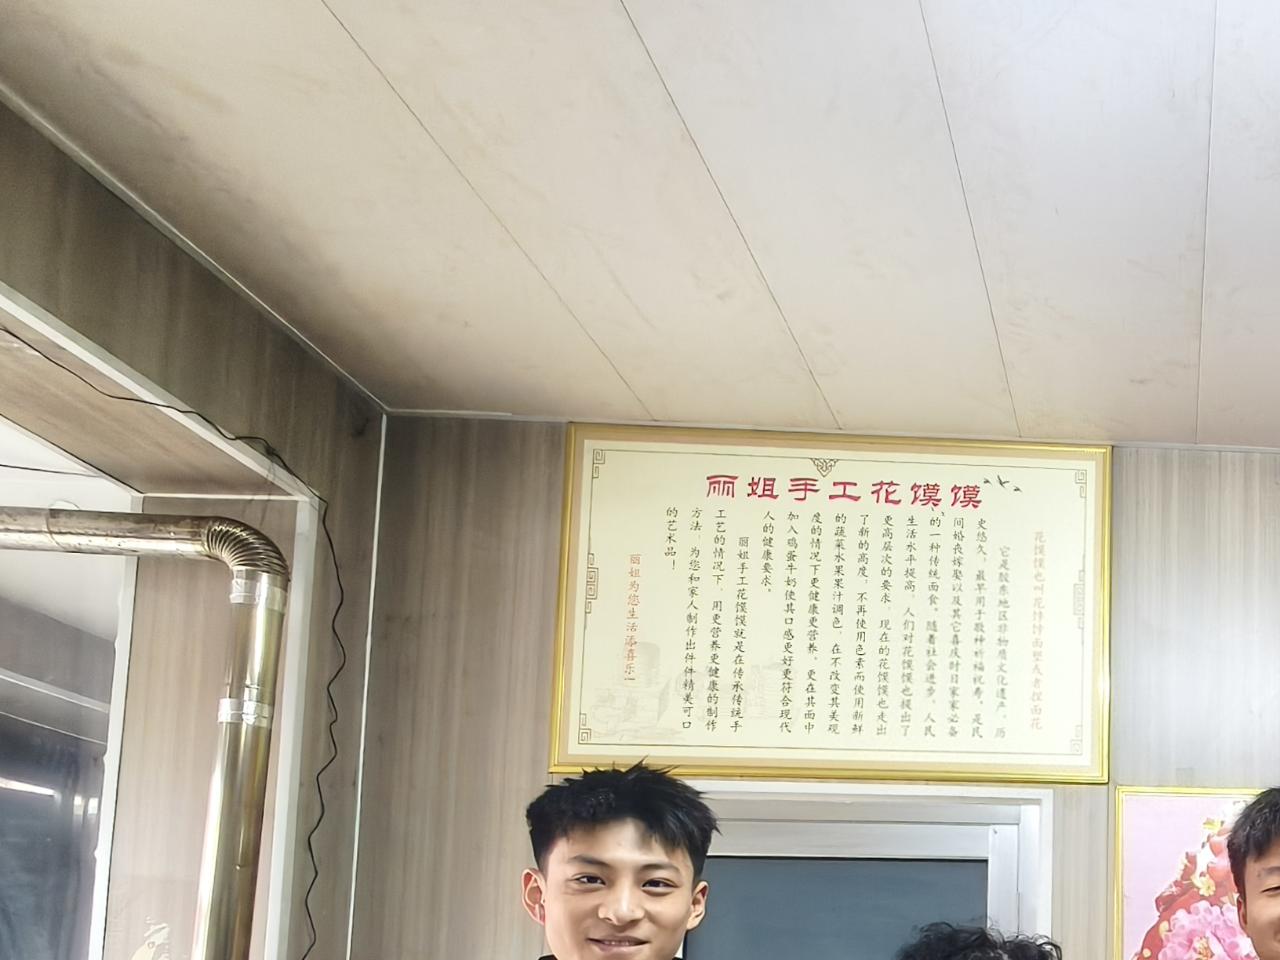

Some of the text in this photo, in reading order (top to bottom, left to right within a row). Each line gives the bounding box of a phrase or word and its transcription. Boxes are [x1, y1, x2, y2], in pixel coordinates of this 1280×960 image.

[706, 474, 982, 508] 丽姐手工花馍馍
